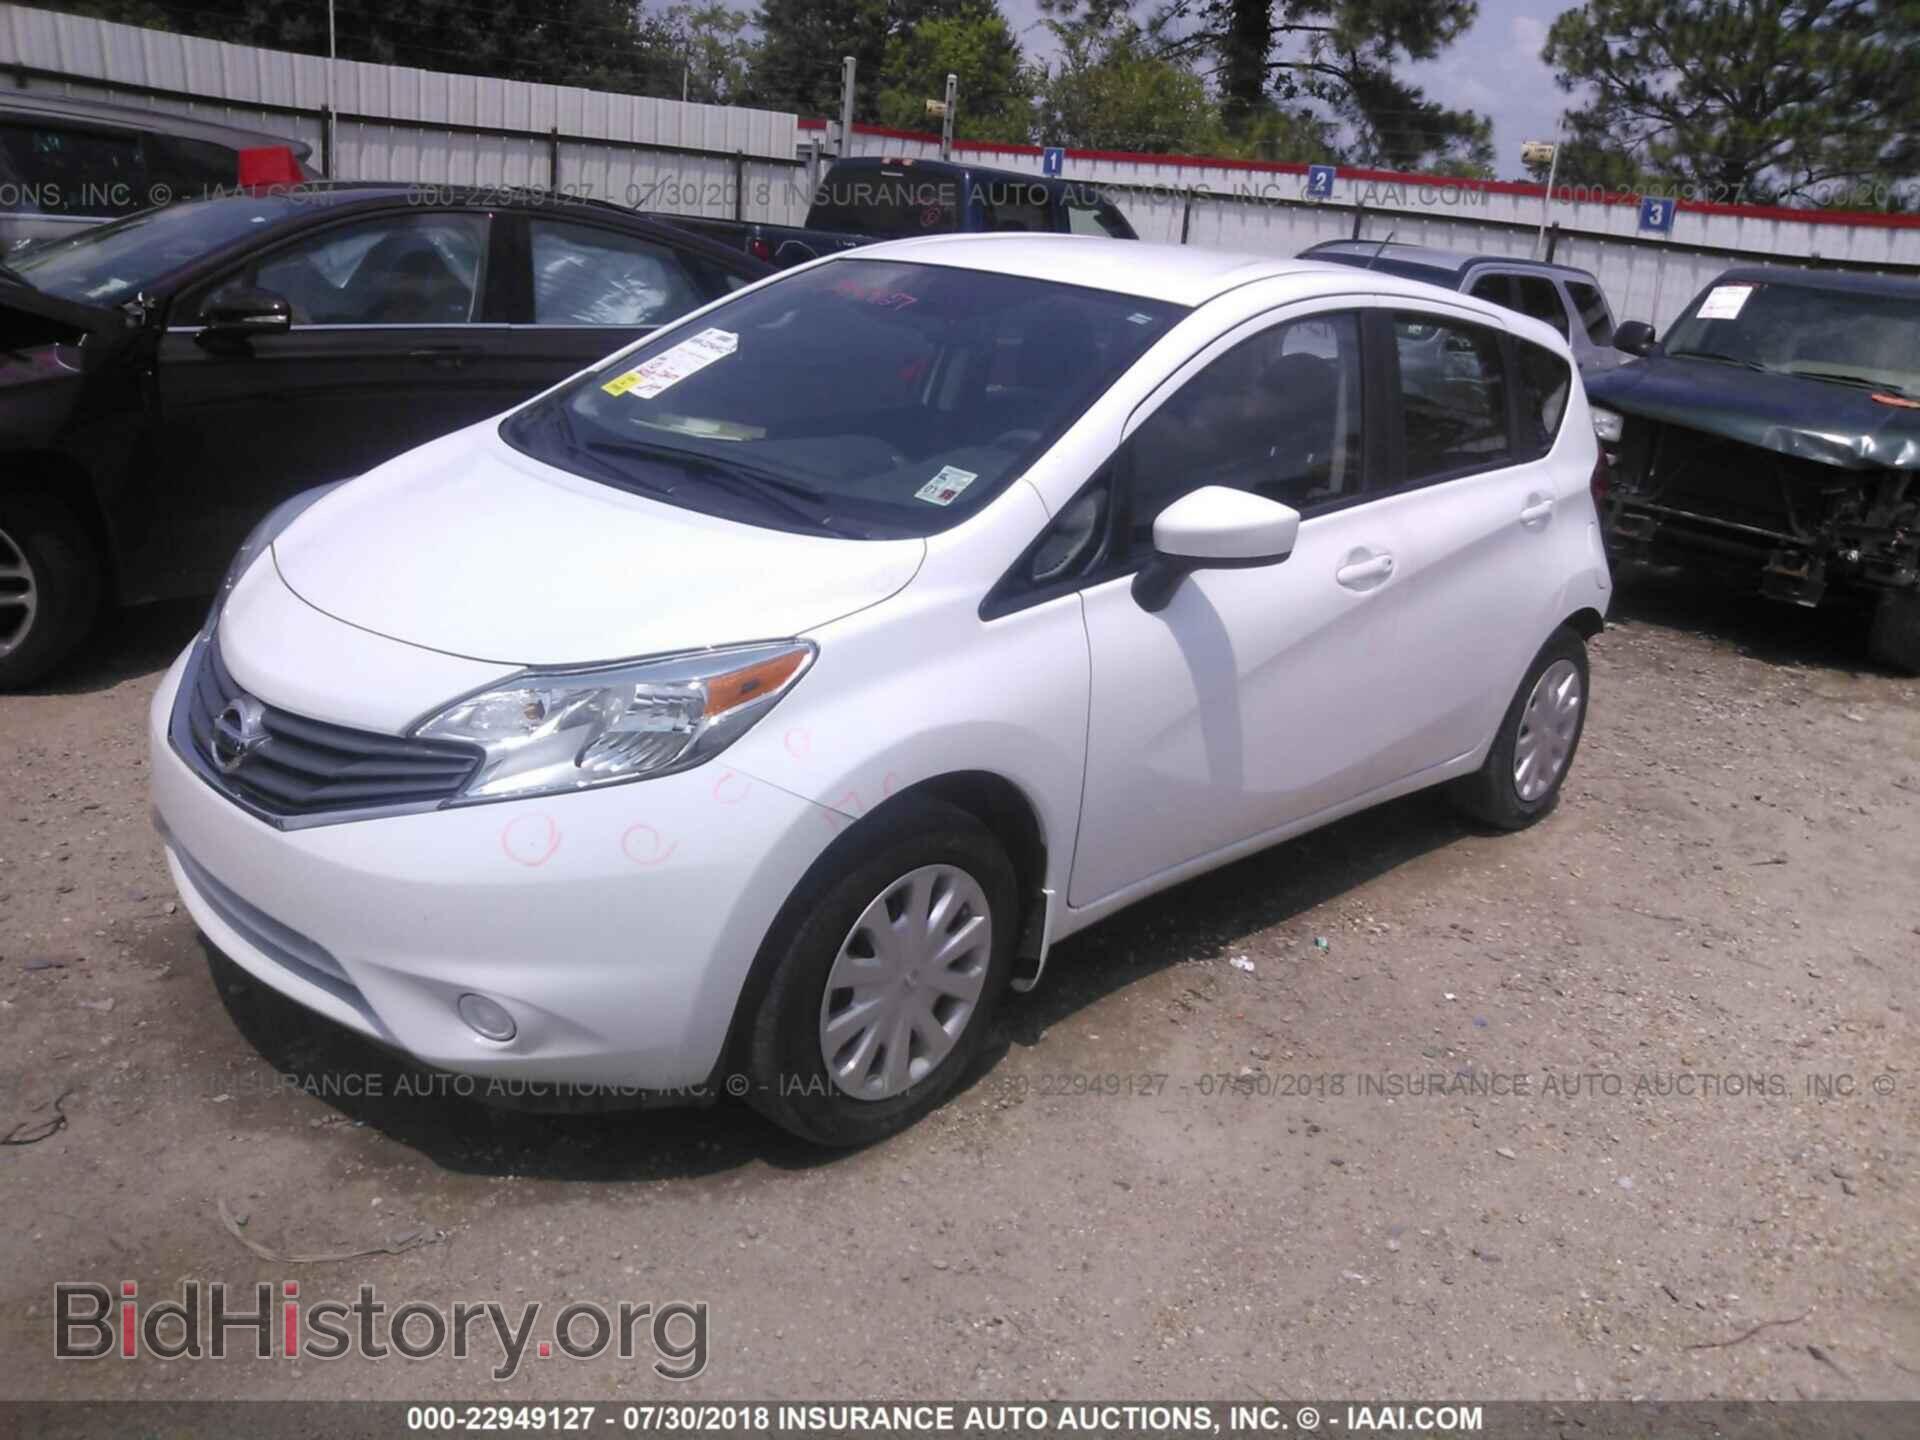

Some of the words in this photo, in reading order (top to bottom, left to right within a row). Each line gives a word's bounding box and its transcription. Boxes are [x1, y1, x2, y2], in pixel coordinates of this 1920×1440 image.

[1050, 152, 1057, 170] 1
[1316, 172, 1327, 191] 2
[1649, 204, 1663, 225] 3
